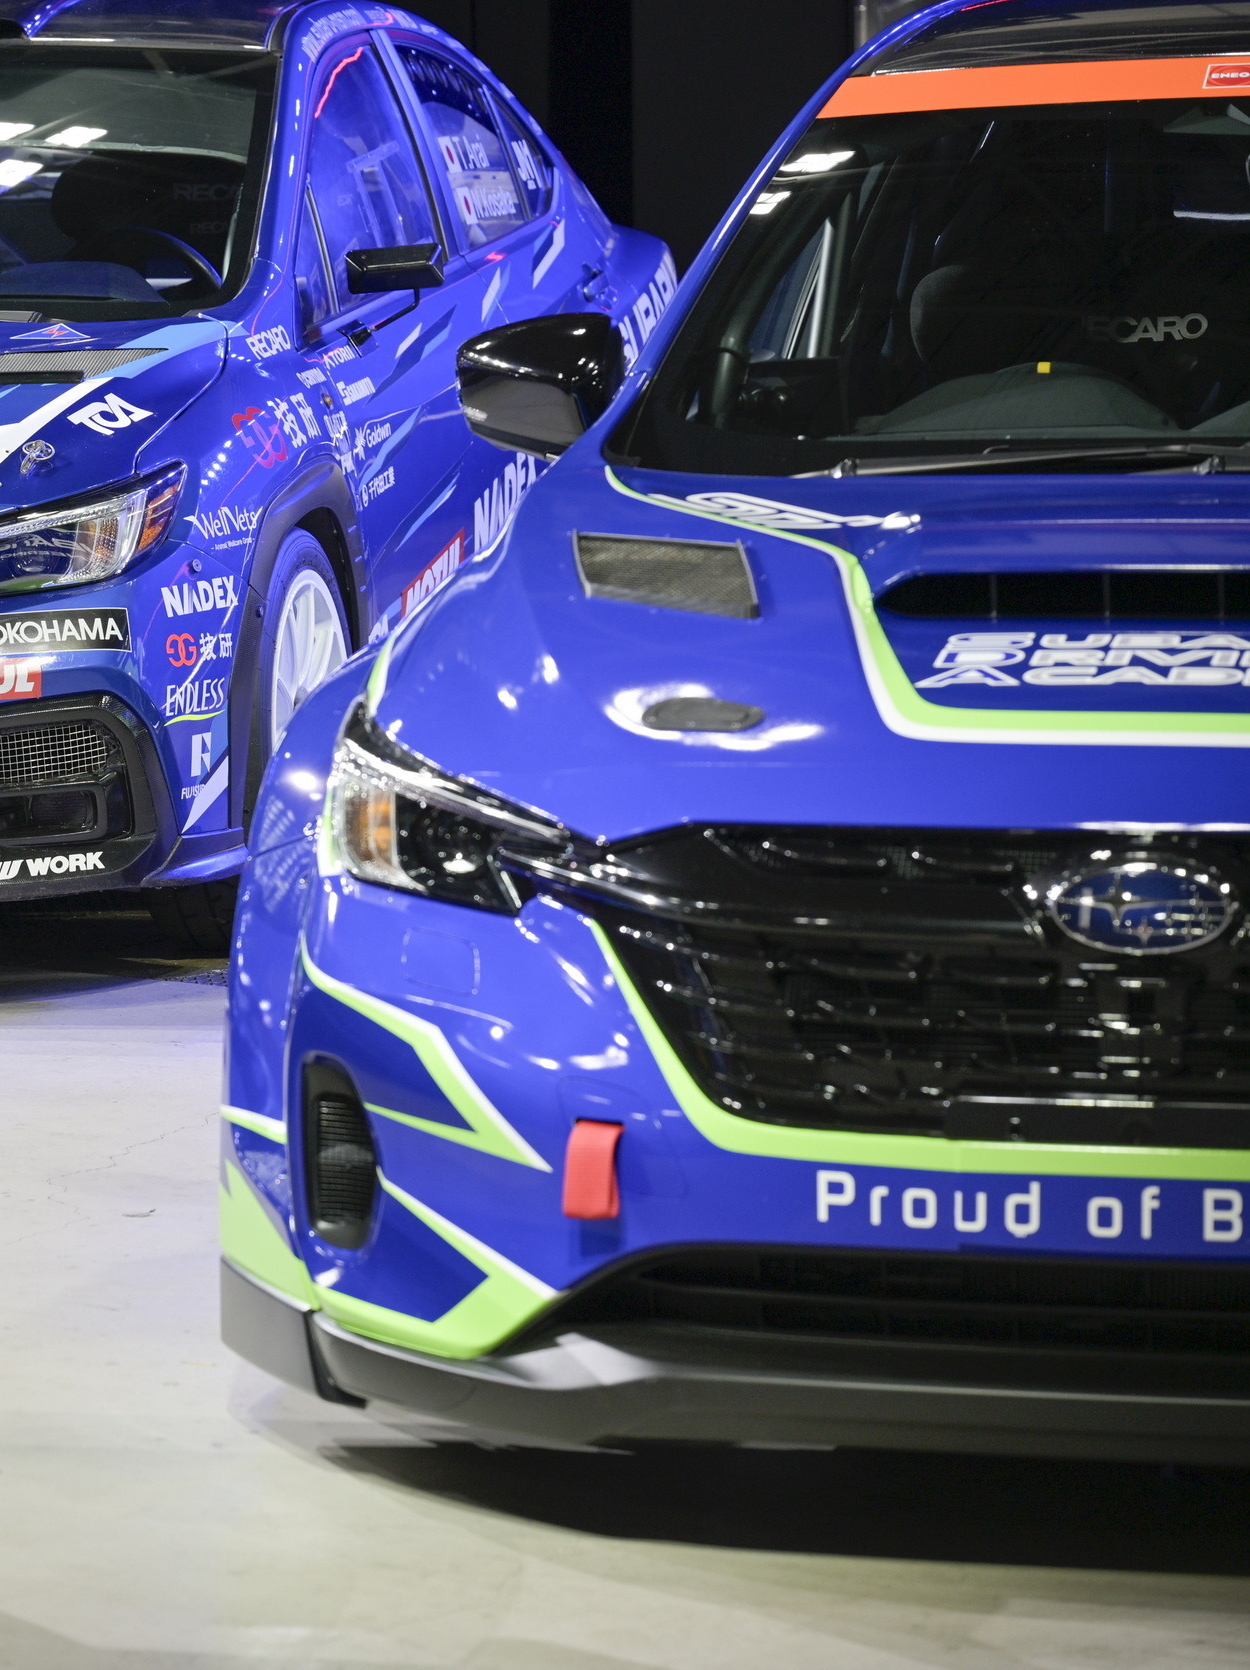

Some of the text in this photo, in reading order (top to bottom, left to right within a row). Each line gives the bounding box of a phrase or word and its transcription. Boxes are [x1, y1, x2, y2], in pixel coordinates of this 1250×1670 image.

[246, 325, 291, 360] RECARO
[1087, 312, 1209, 343] ECARO
[68, 392, 153, 435] TOA
[365, 423, 392, 448] Goldwin
[160, 575, 238, 617] NADEX
[199, 632, 233, 661] 技研
[913, 664, 1250, 688] ACAD
[165, 677, 225, 716] ENDLESS
[26, 852, 105, 876] WORK
[816, 1169, 1041, 1237] Proud
[1087, 1185, 1161, 1240] of
